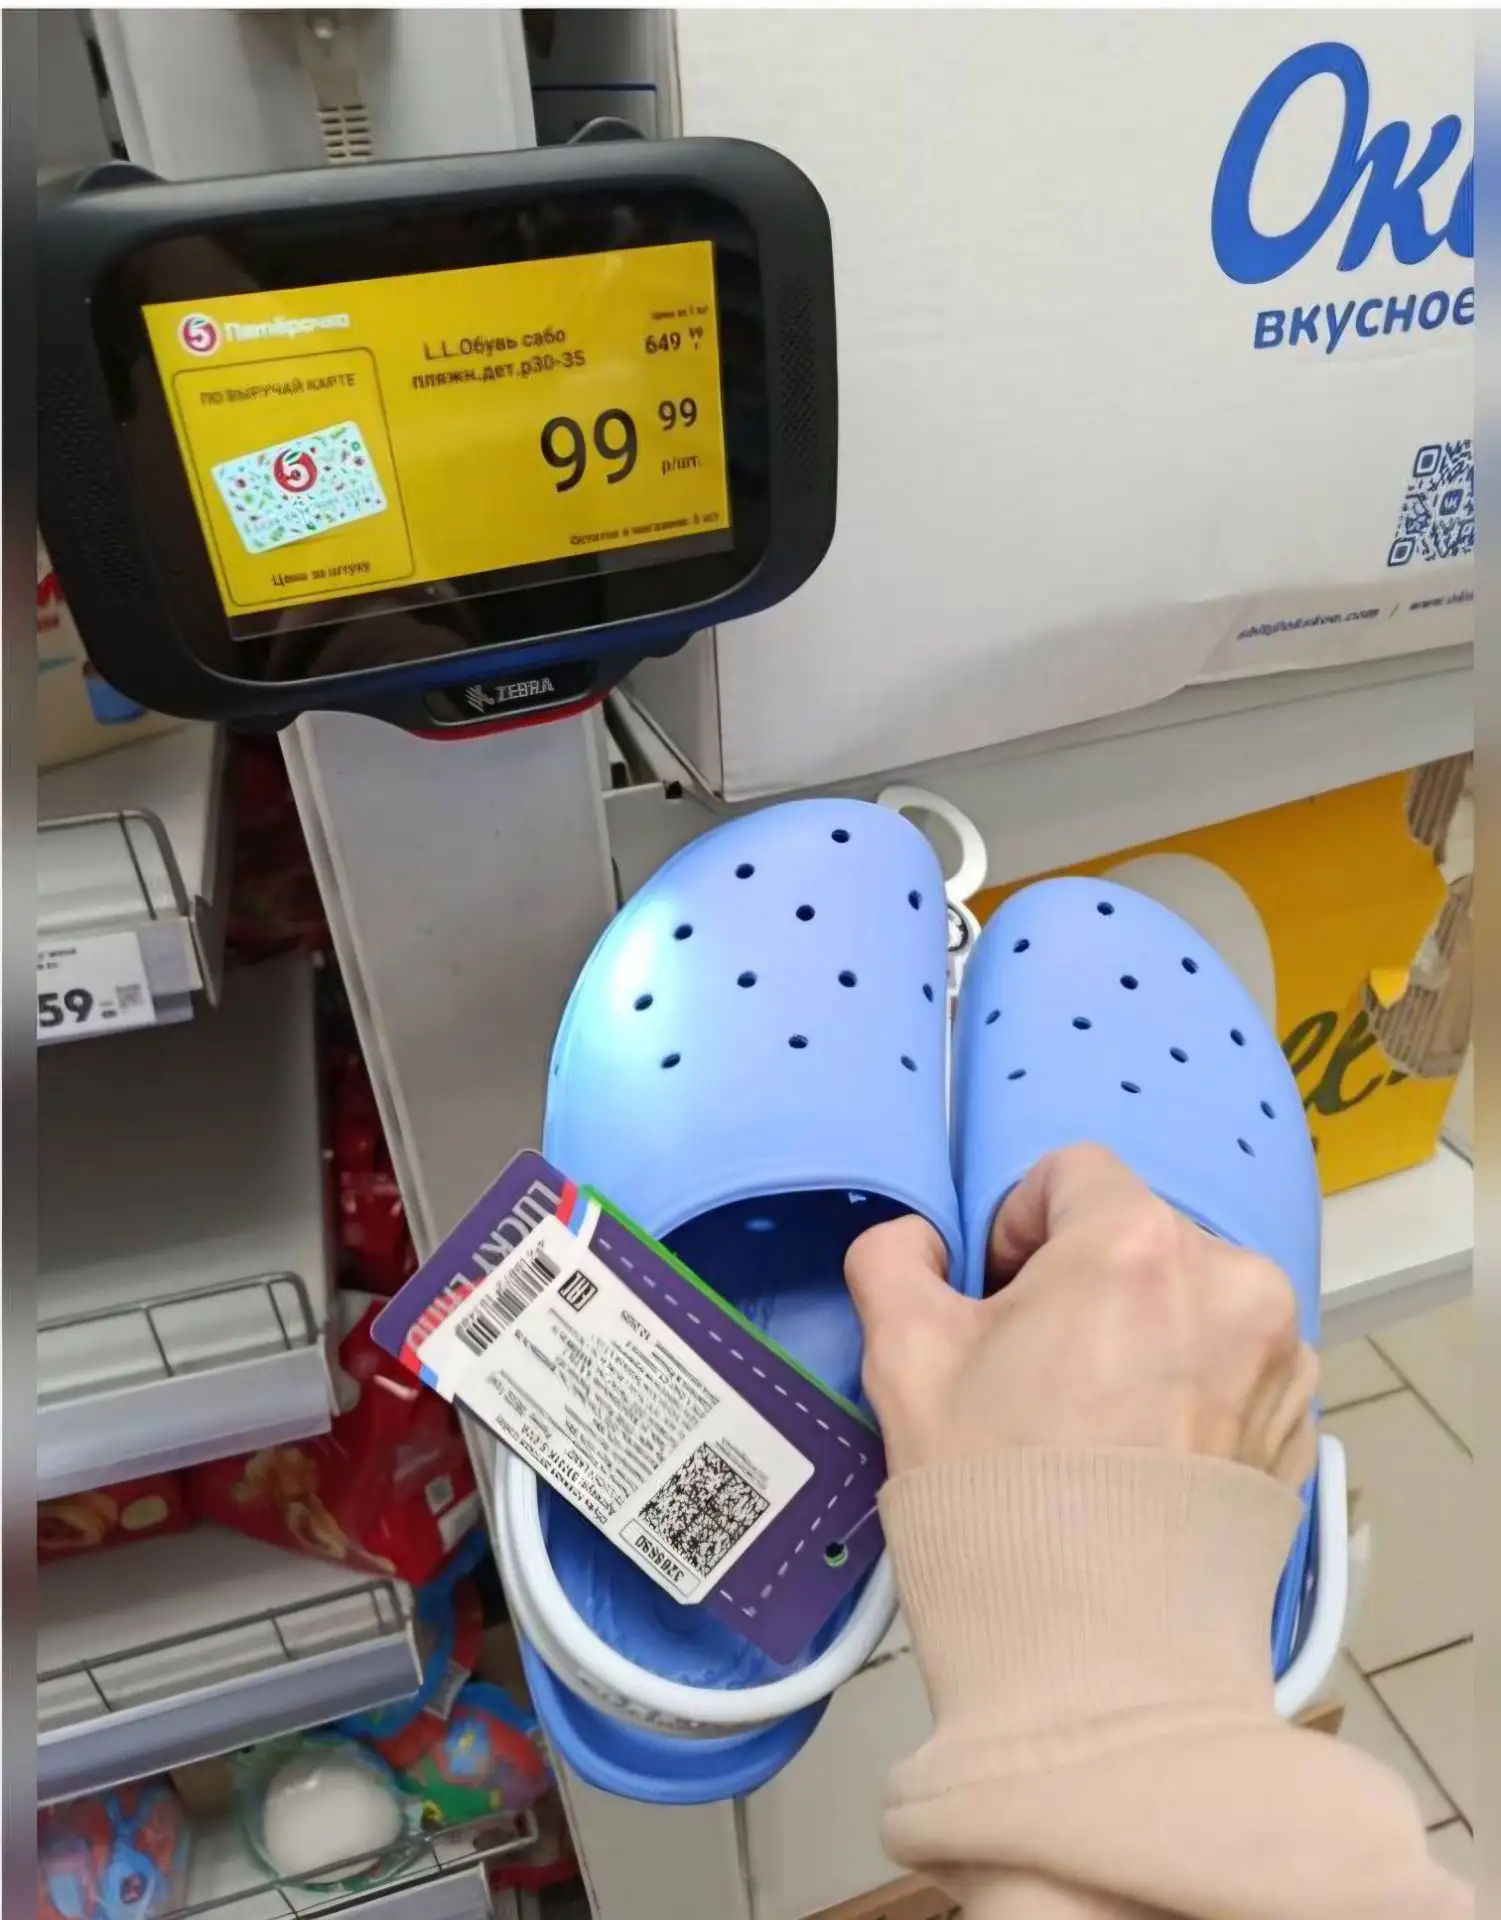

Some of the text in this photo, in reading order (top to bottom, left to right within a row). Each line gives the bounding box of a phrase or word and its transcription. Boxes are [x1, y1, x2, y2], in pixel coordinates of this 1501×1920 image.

[1254, 286, 1474, 355] вкусное
[521, 326, 566, 348] сабо
[645, 332, 681, 355] 649
[540, 397, 698, 493] 99 99
[494, 677, 555, 702] ZEBRA
[38, 988, 94, 1028] 59
